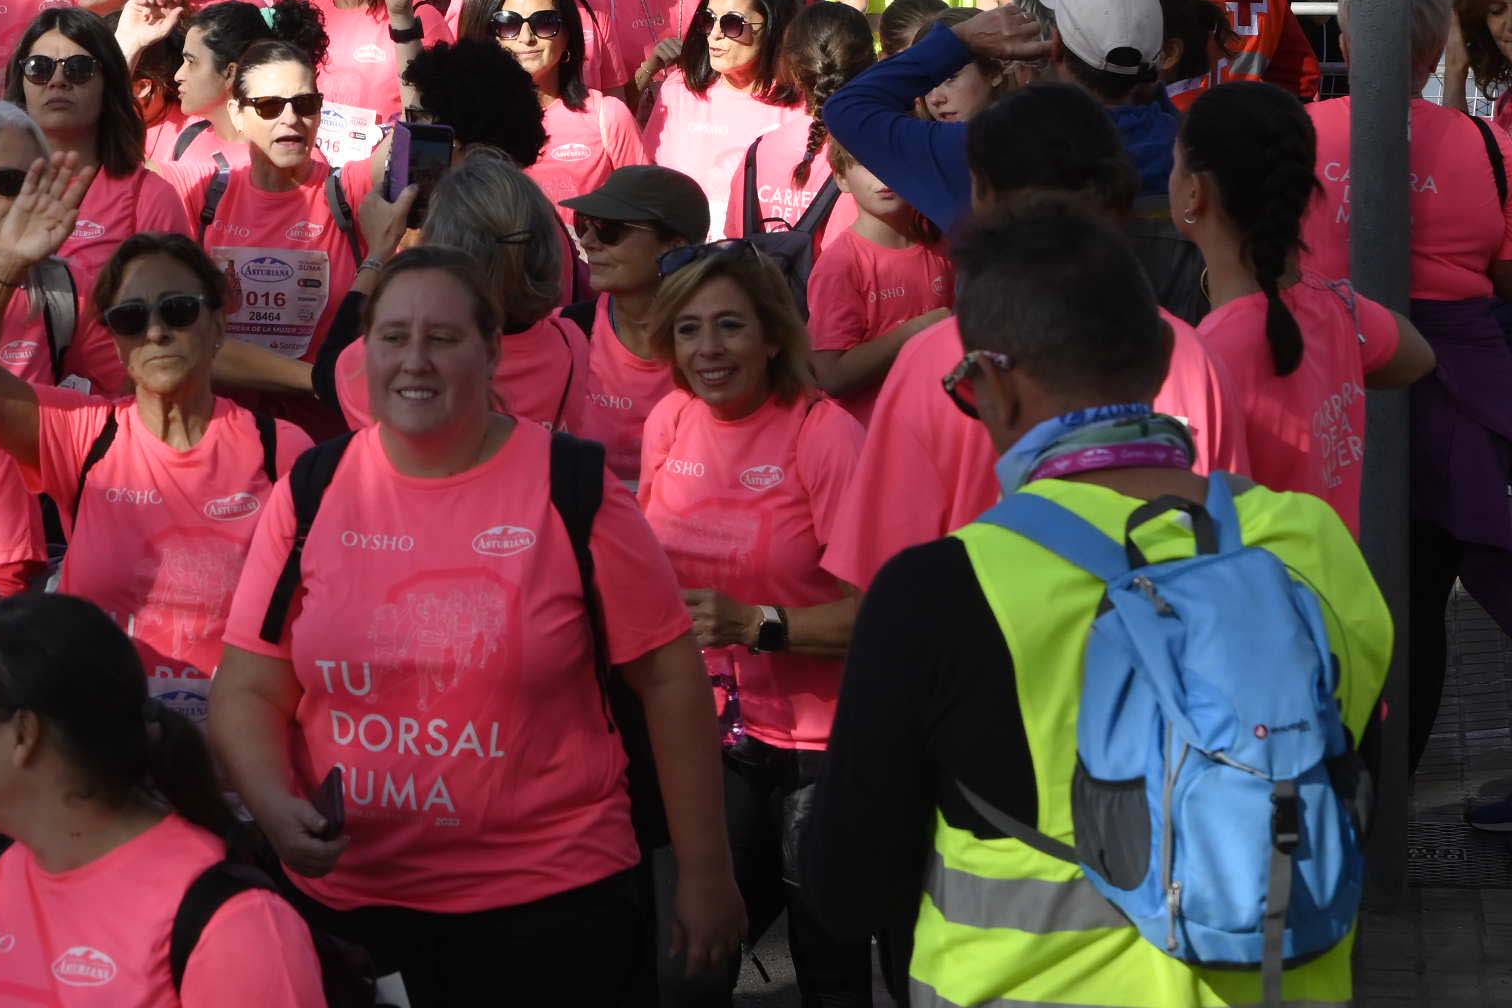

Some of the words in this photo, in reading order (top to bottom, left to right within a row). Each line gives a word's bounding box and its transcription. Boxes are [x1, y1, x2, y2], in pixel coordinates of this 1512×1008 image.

[245, 265, 291, 278] ASTURIANA
[246, 291, 287, 308] 016
[870, 287, 905, 303] OSHO
[248, 310, 281, 323] 28464
[586, 392, 633, 410] YSHO
[666, 458, 705, 478] YSHO
[105, 487, 163, 505] OYSHO
[342, 529, 415, 553] OYSHO
[477, 536, 530, 551] ASTURIANA
[316, 660, 372, 696] TU
[330, 710, 505, 759] DORSAL
